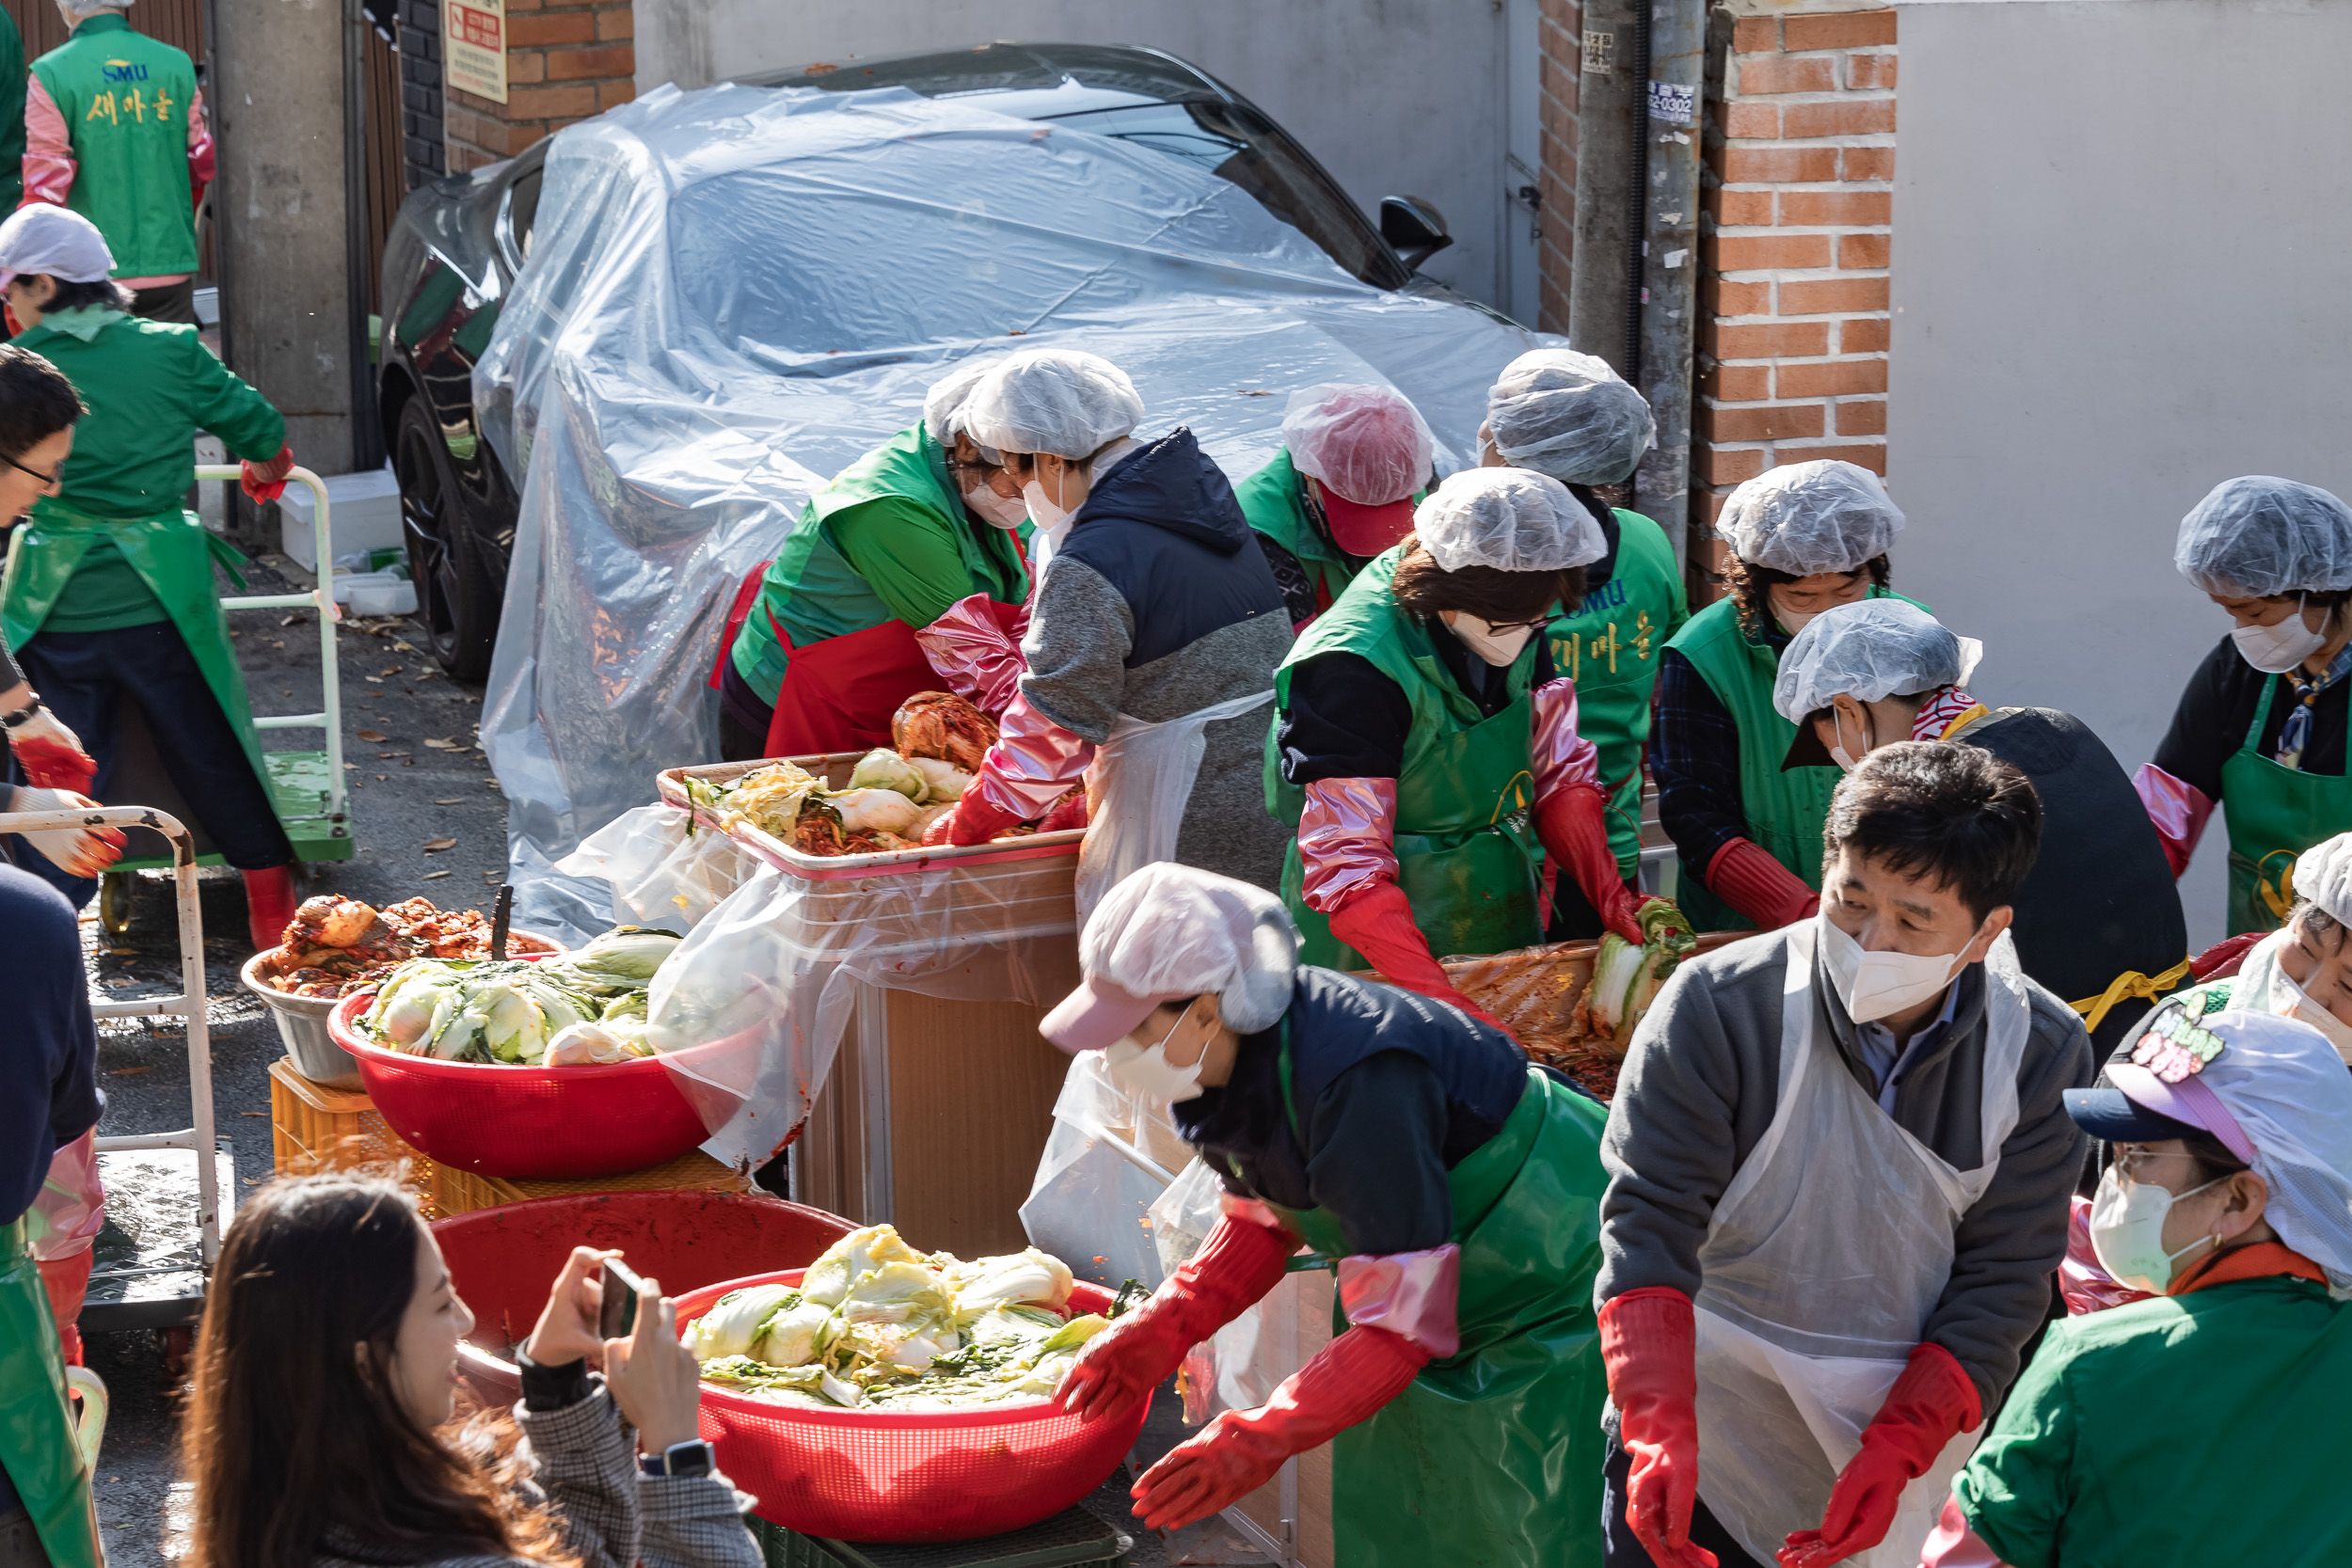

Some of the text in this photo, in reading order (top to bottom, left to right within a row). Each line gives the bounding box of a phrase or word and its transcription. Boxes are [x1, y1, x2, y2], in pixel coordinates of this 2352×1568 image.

[103, 61, 149, 84] SMU
[86, 87, 174, 125] 새마을
[1565, 578, 1628, 620] MU
